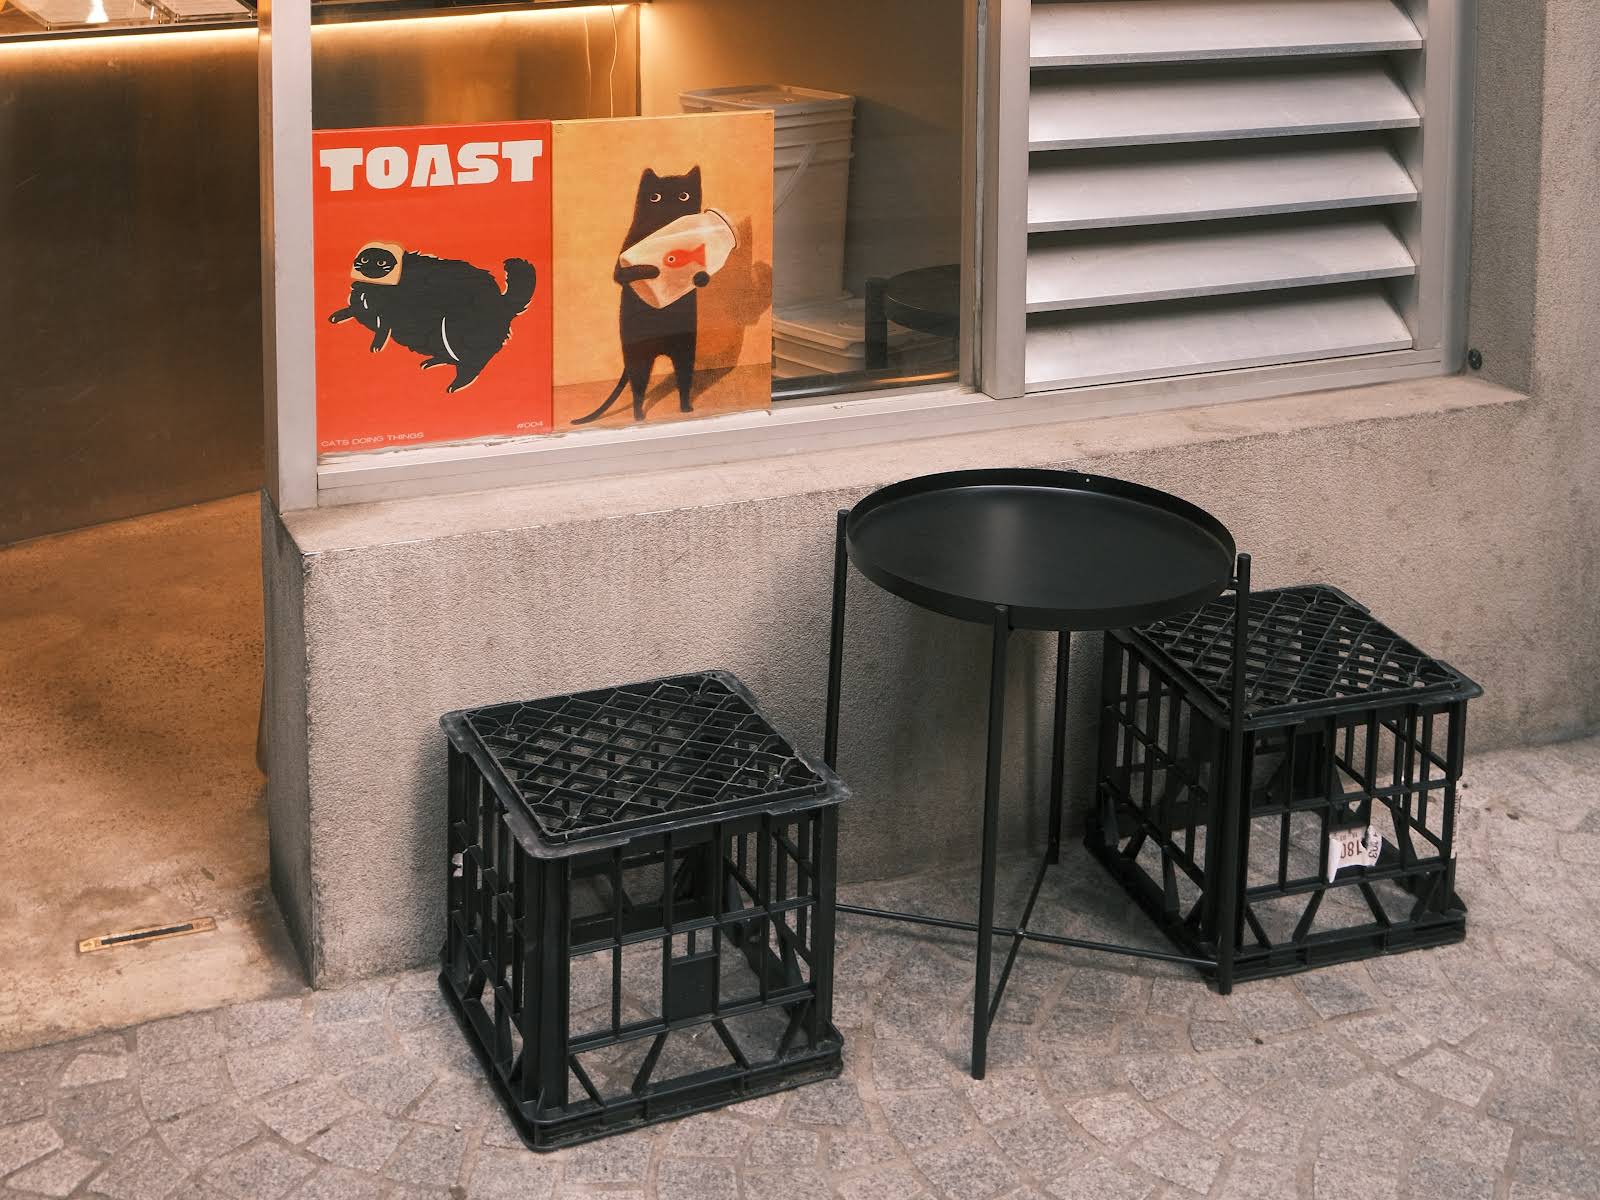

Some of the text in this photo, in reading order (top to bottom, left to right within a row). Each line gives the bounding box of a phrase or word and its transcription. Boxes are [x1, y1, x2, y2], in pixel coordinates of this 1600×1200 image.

[319, 139, 544, 193] TOAST
[320, 431, 424, 448] CATS DOING THINGS
